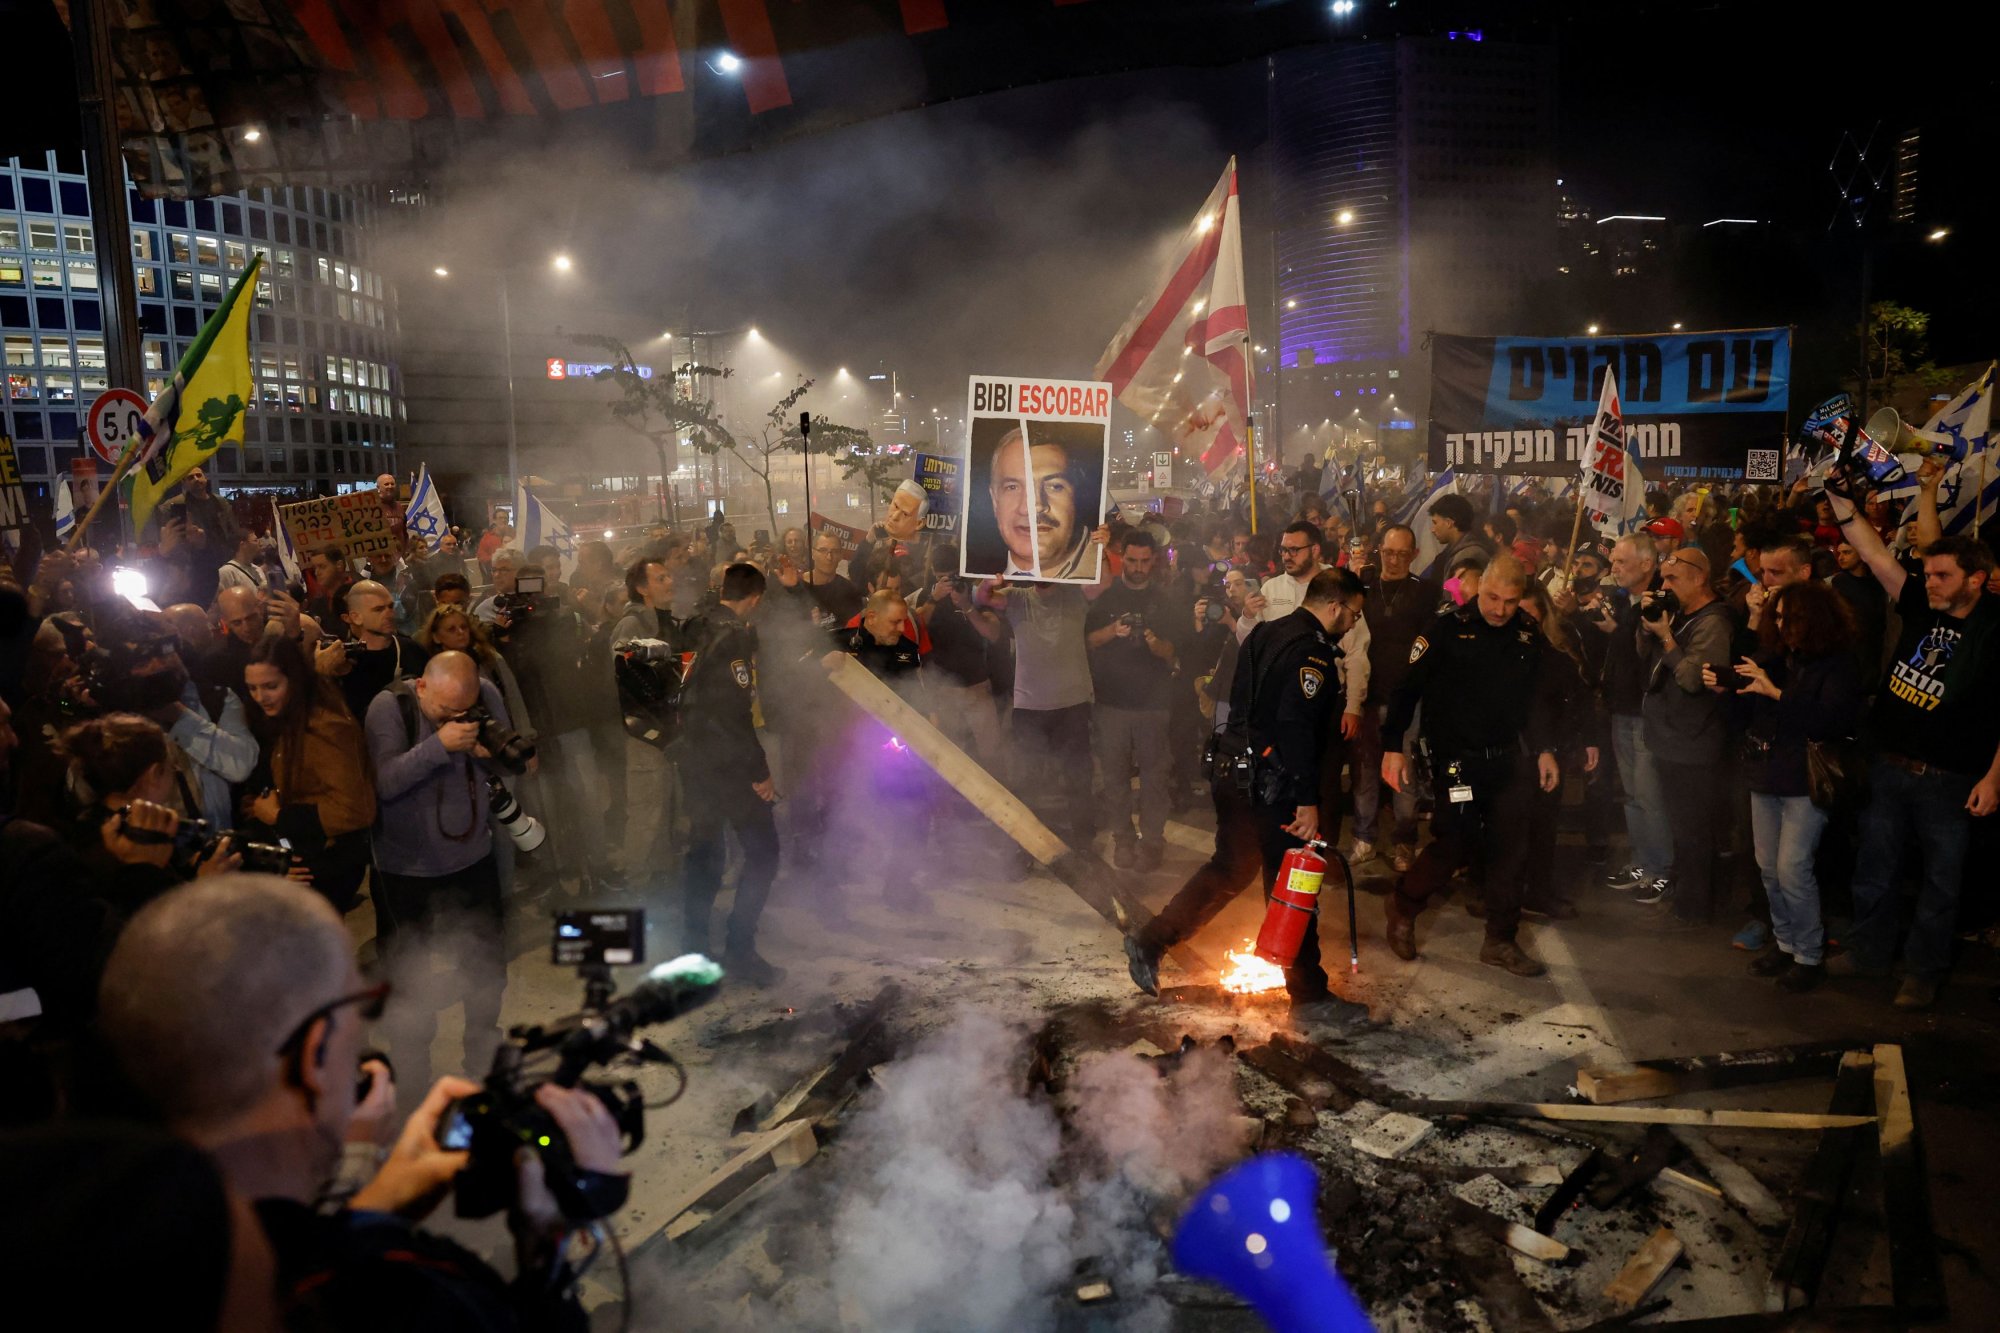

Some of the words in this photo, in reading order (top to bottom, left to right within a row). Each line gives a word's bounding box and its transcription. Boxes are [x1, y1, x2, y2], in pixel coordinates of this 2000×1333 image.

[1687, 339, 1773, 403] עם
[974, 382, 1013, 412] BIBI
[1018, 384, 1109, 417] ESCOBAR
[104, 410, 141, 441] 5.0
[1446, 429, 1555, 468] מפקירה
[1566, 422, 1681, 461] ממה
[338, 507, 383, 522] מירון
[340, 492, 377, 508] הדם
[296, 515, 332, 531] כבר
[296, 528, 335, 545] בדם
[926, 513, 958, 531] עכש
[1893, 660, 1945, 698] חובה
